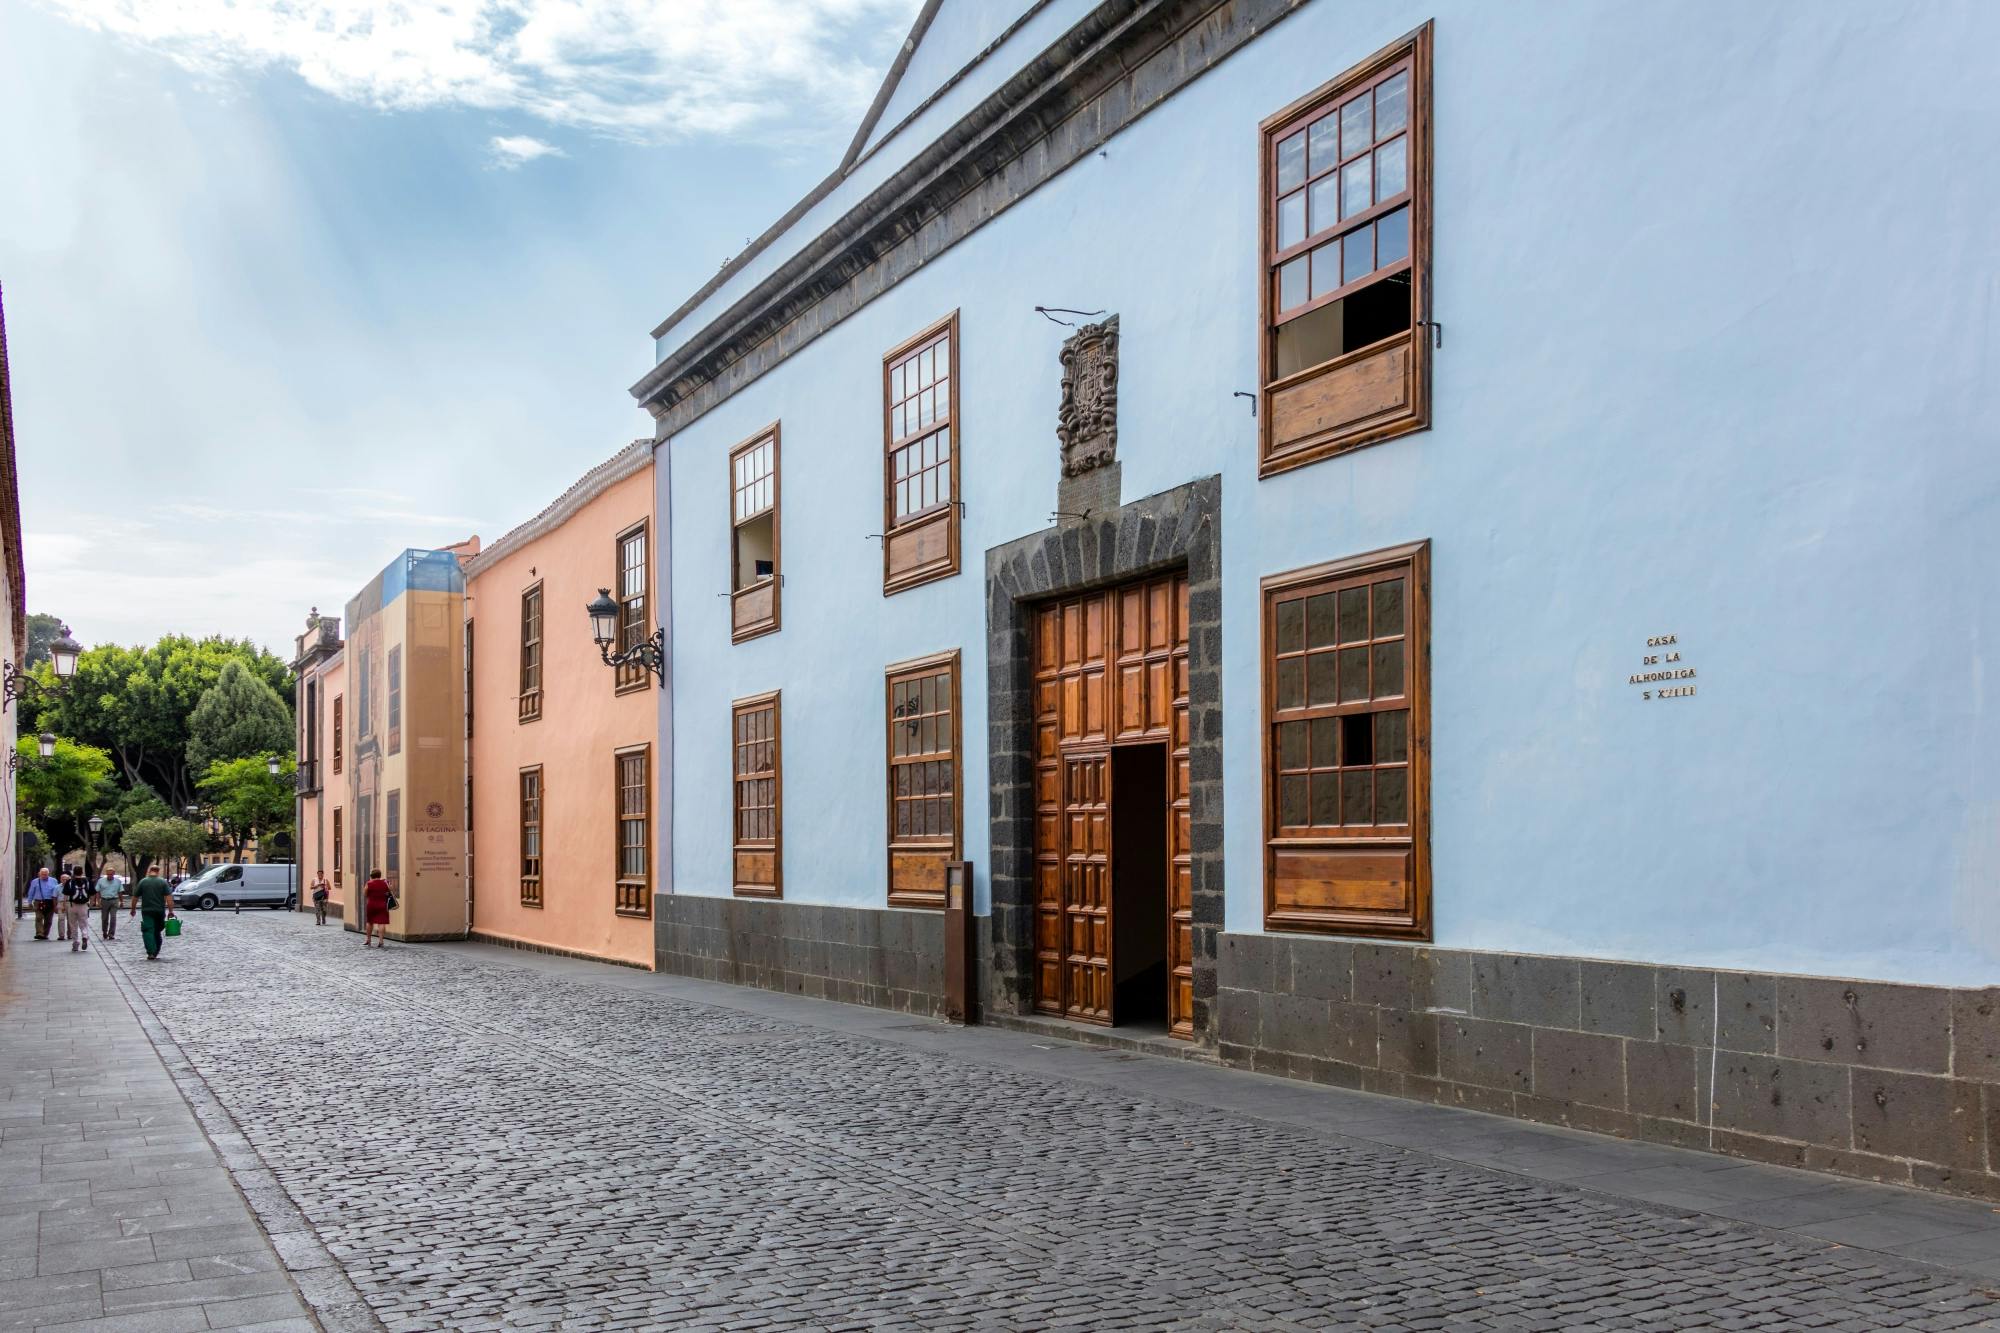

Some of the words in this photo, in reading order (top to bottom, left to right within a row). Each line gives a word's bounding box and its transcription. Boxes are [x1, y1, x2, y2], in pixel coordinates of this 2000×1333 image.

[1647, 635, 1677, 647] CASA
[1643, 655, 1658, 665] DE
[1665, 652, 1681, 663] LA
[1629, 668, 1697, 684] ALHONDIGA
[1642, 691, 1651, 700] S
